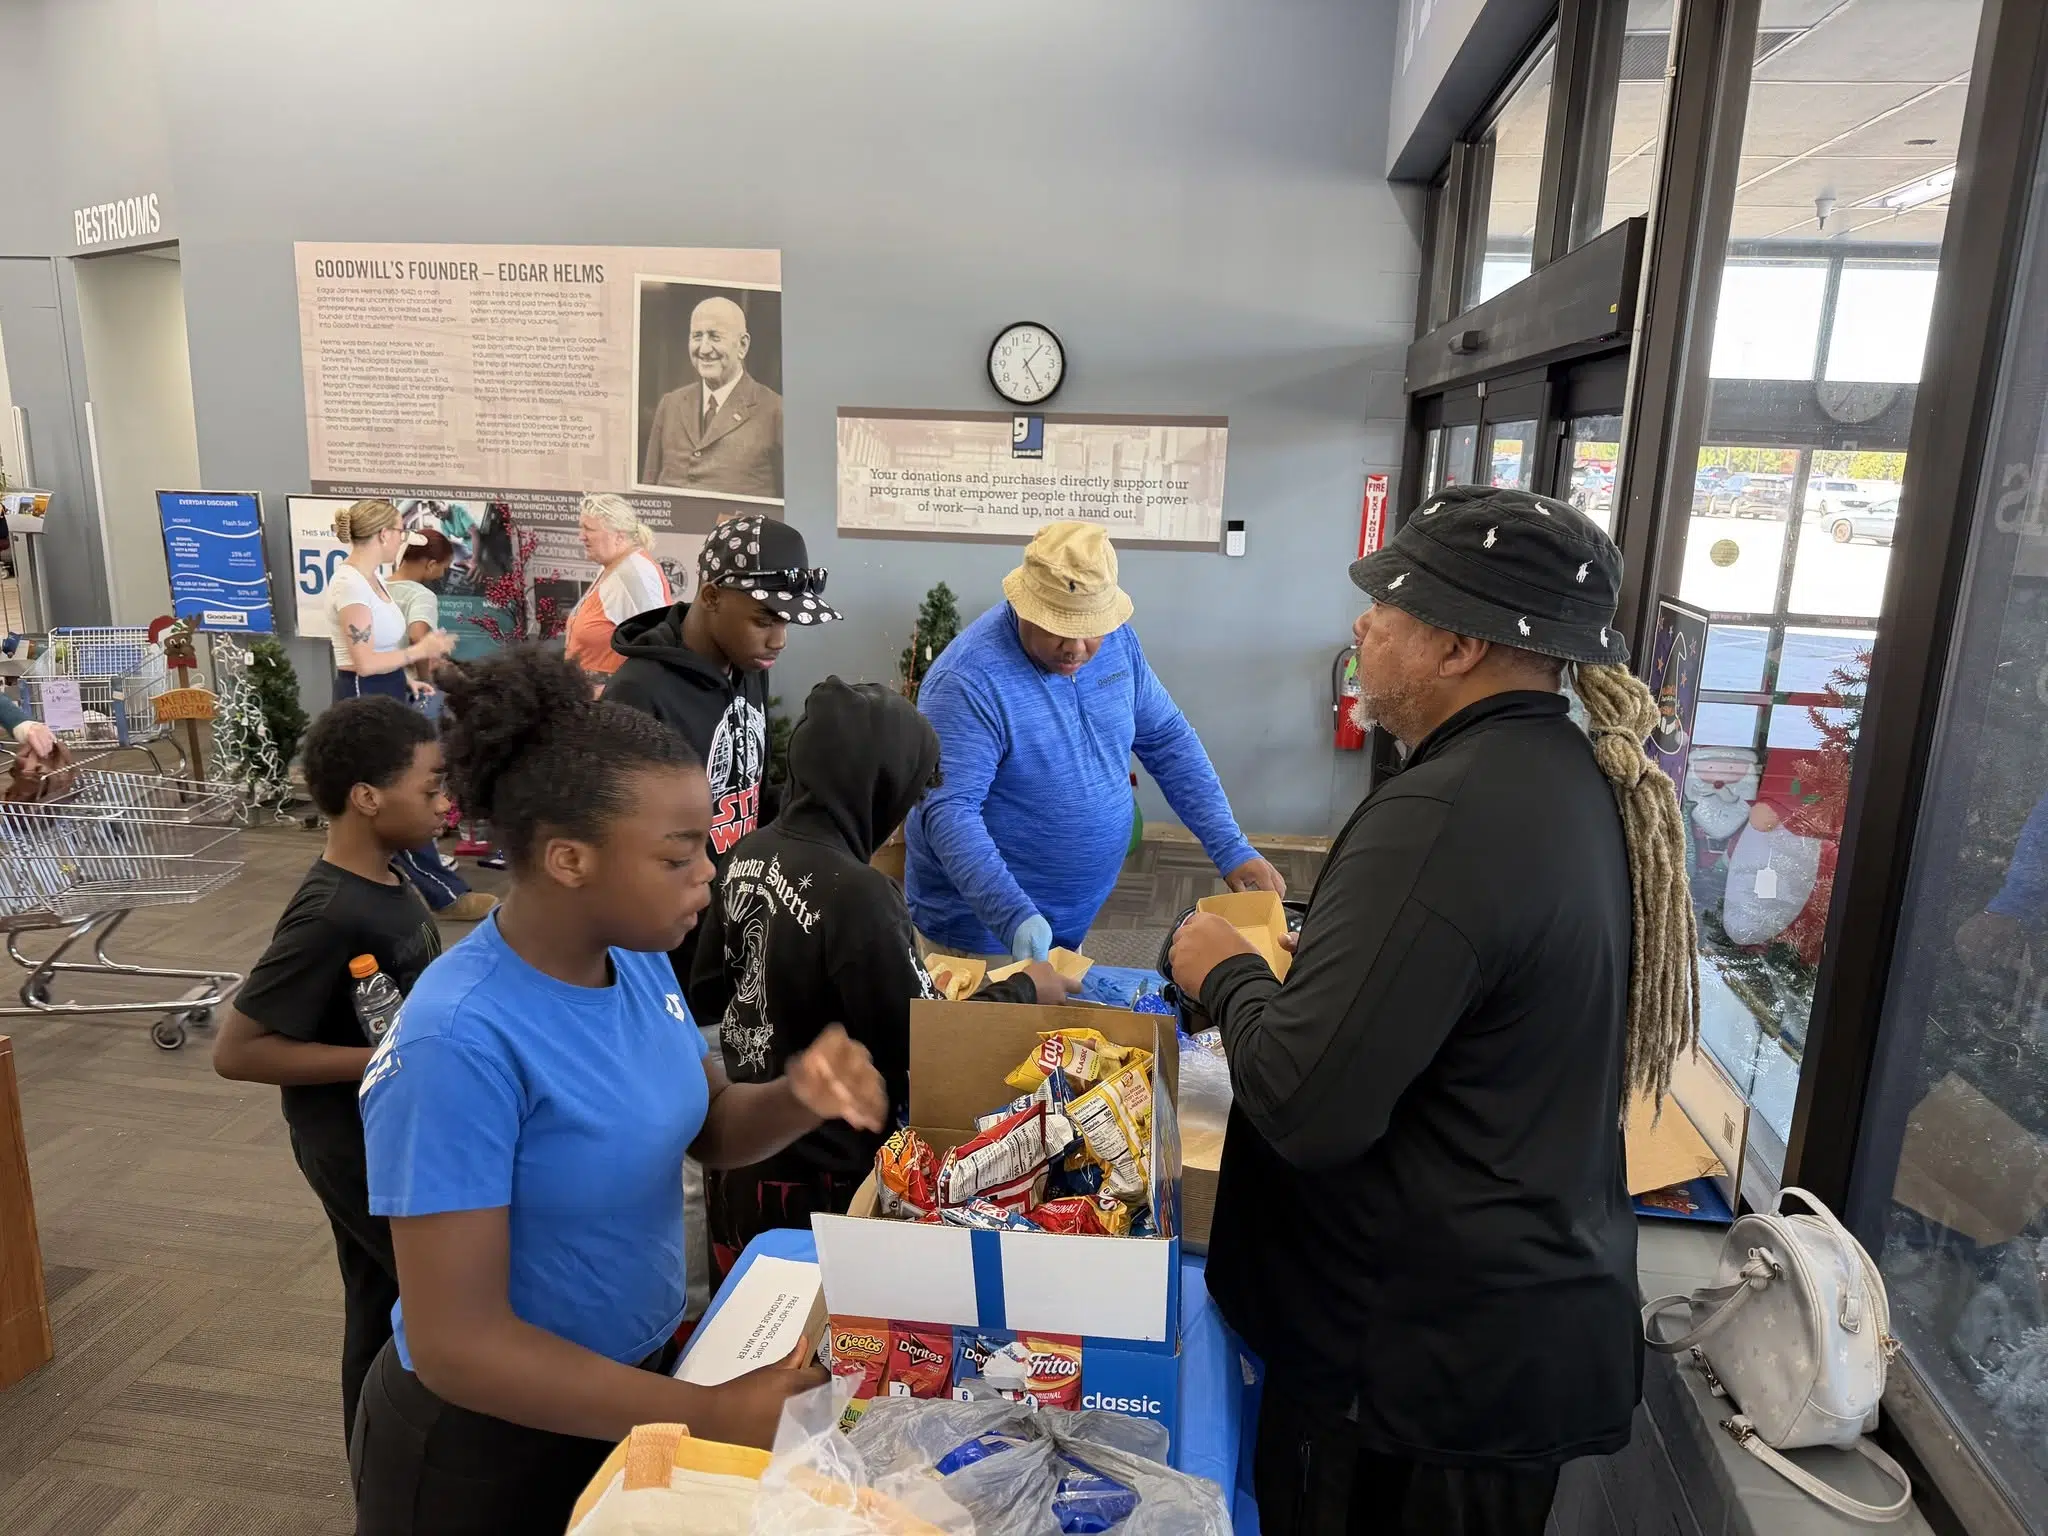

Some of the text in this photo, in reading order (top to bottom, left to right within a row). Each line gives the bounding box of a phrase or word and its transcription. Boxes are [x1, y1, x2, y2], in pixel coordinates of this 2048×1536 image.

[73, 192, 160, 246] RESTROOMS
[315, 259, 404, 279] GOODWILL'S
[409, 261, 479, 281] FOUNDER
[498, 263, 549, 282] EDGAR
[553, 264, 604, 284] HELMS
[870, 468, 1189, 491] Your donations and purchases directly support our
[1368, 482, 1386, 493] FIRE
[356, 487, 380, 495] DURING
[381, 488, 416, 496] GOODWILL'S
[417, 490, 454, 498] CENTENNIAL
[505, 493, 530, 501] BRONZE
[531, 494, 567, 502] MEDALLION
[640, 500, 662, 508] ADDED
[662, 500, 672, 508] TO
[870, 486, 1189, 507] programs that empower people through the power
[918, 501, 930, 511] of
[988, 503, 1019, 515] hand
[1022, 507, 1042, 518] up,
[1045, 506, 1064, 517] not
[1068, 508, 1075, 517] a
[1078, 506, 1110, 518] hand
[1113, 509, 1137, 519] out.
[442, 601, 472, 610] recycling
[158, 704, 213, 720] CHRISTMA
[1076, 1048, 1088, 1074] CLASSIC
[788, 1295, 800, 1310] FREE
[736, 1293, 787, 1360] GATORADE AND WATER
[778, 1310, 790, 1323] HOT
[836, 1333, 883, 1353] Cheetos
[899, 1340, 944, 1364] Doritos
[1028, 1352, 1079, 1376] Fritos
[898, 1385, 904, 1394] 7
[962, 1391, 968, 1400] 6
[1026, 1398, 1032, 1407] 4
[1083, 1392, 1161, 1414] classic
